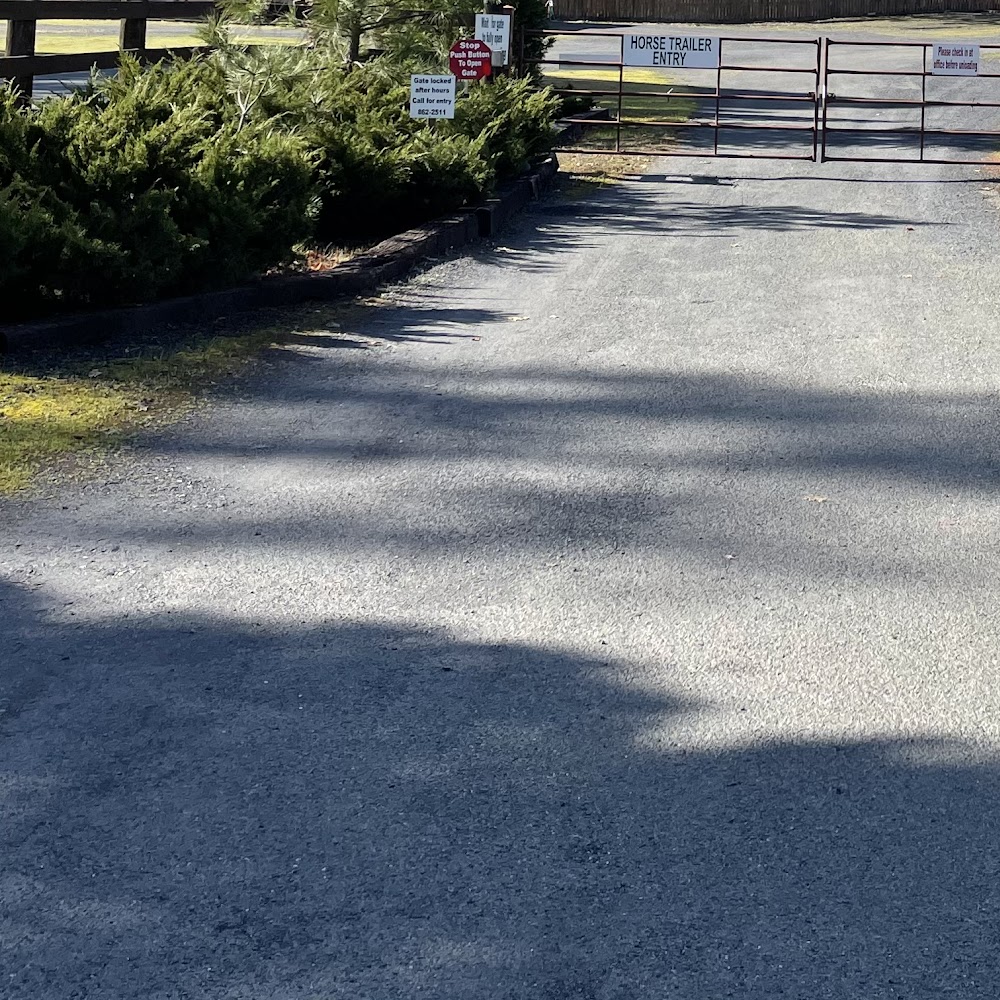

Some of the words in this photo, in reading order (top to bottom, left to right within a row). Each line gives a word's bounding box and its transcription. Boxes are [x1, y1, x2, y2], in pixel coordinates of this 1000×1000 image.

[460, 41, 480, 50] Stop
[631, 35, 666, 50] HORSE
[669, 37, 711, 52] TRAILER
[938, 46, 951, 57] Please
[467, 60, 482, 68] Open
[653, 51, 686, 66] ENTRY
